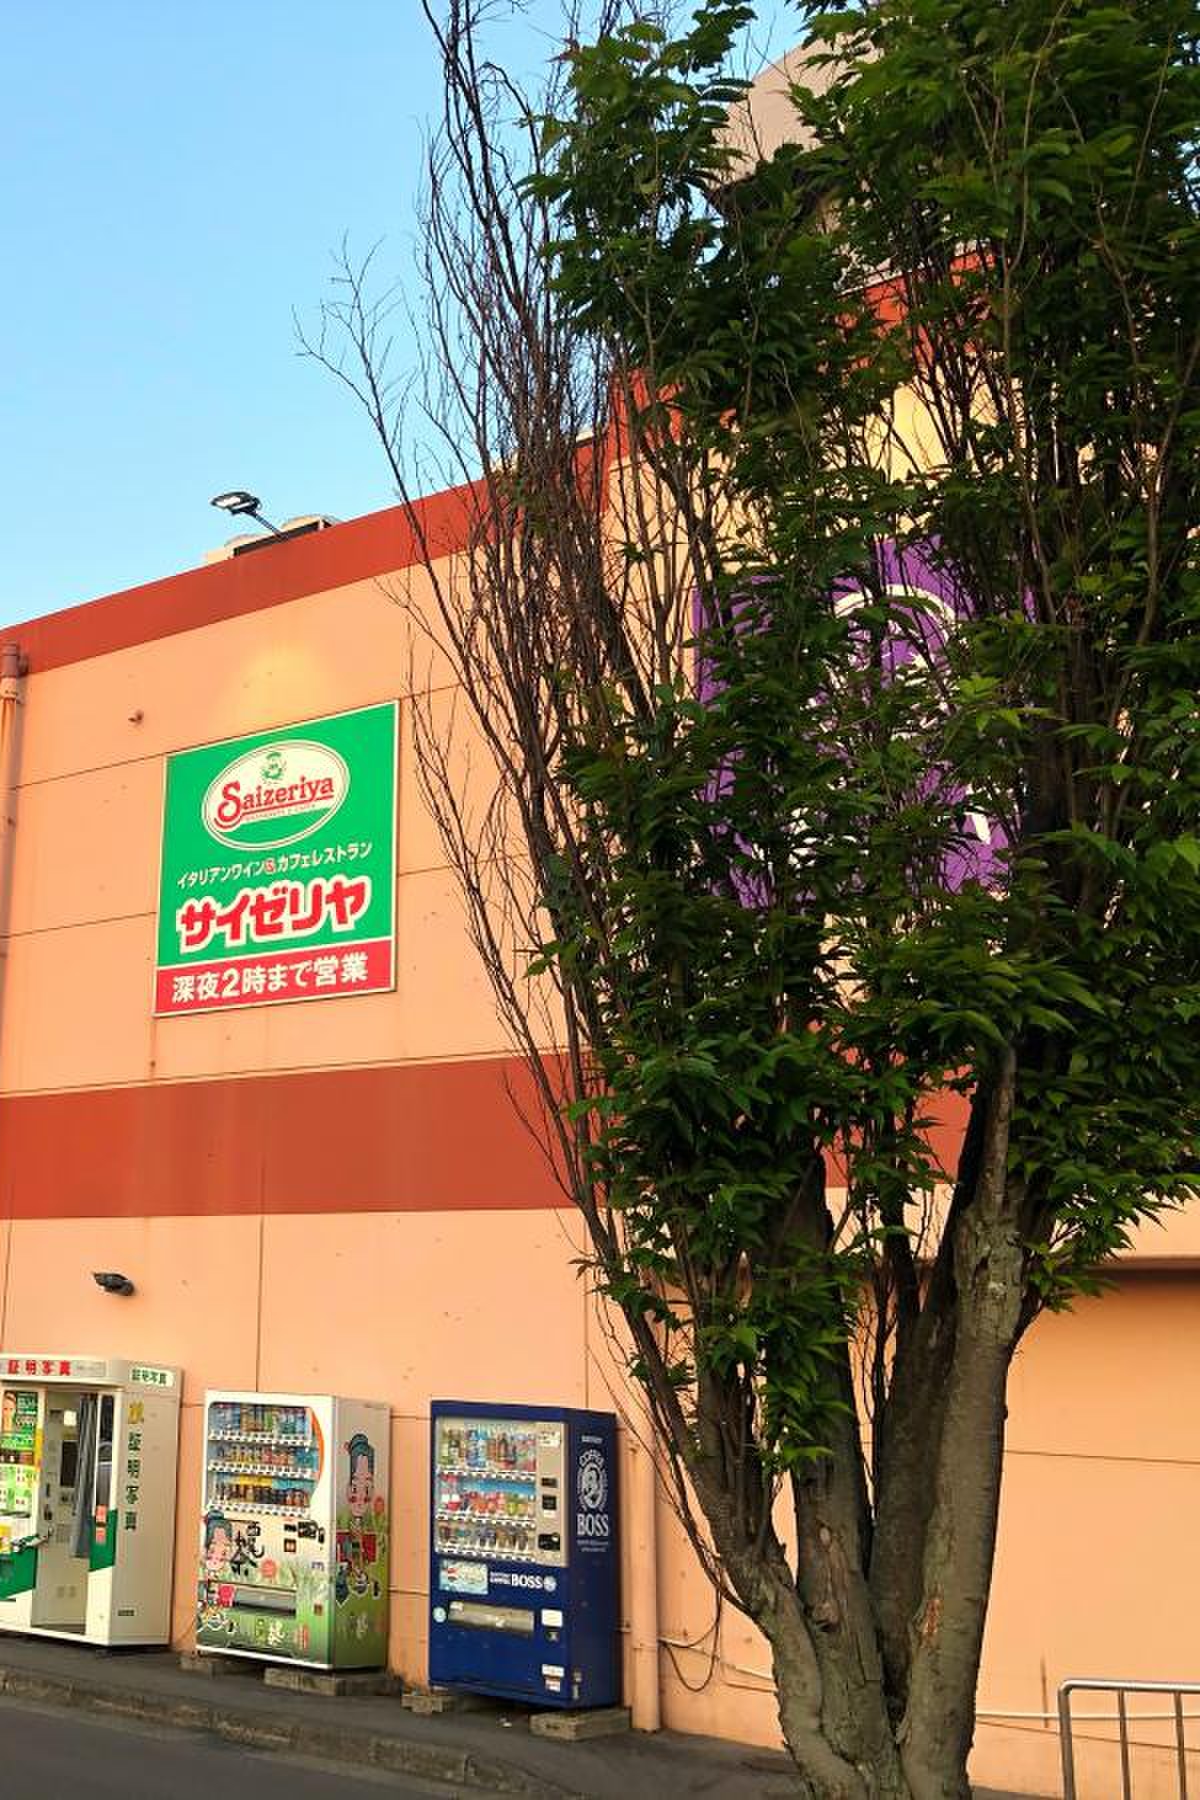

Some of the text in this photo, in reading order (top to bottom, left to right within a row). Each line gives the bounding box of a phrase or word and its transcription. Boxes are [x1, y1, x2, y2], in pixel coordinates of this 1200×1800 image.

[213, 776, 335, 829] Saizeriya
[179, 878, 368, 950] サイゼリヤ
[172, 952, 369, 1003] 深夜2時まで営業
[576, 1513, 609, 1537] BOSS
[511, 1573, 544, 1590] BOSS
